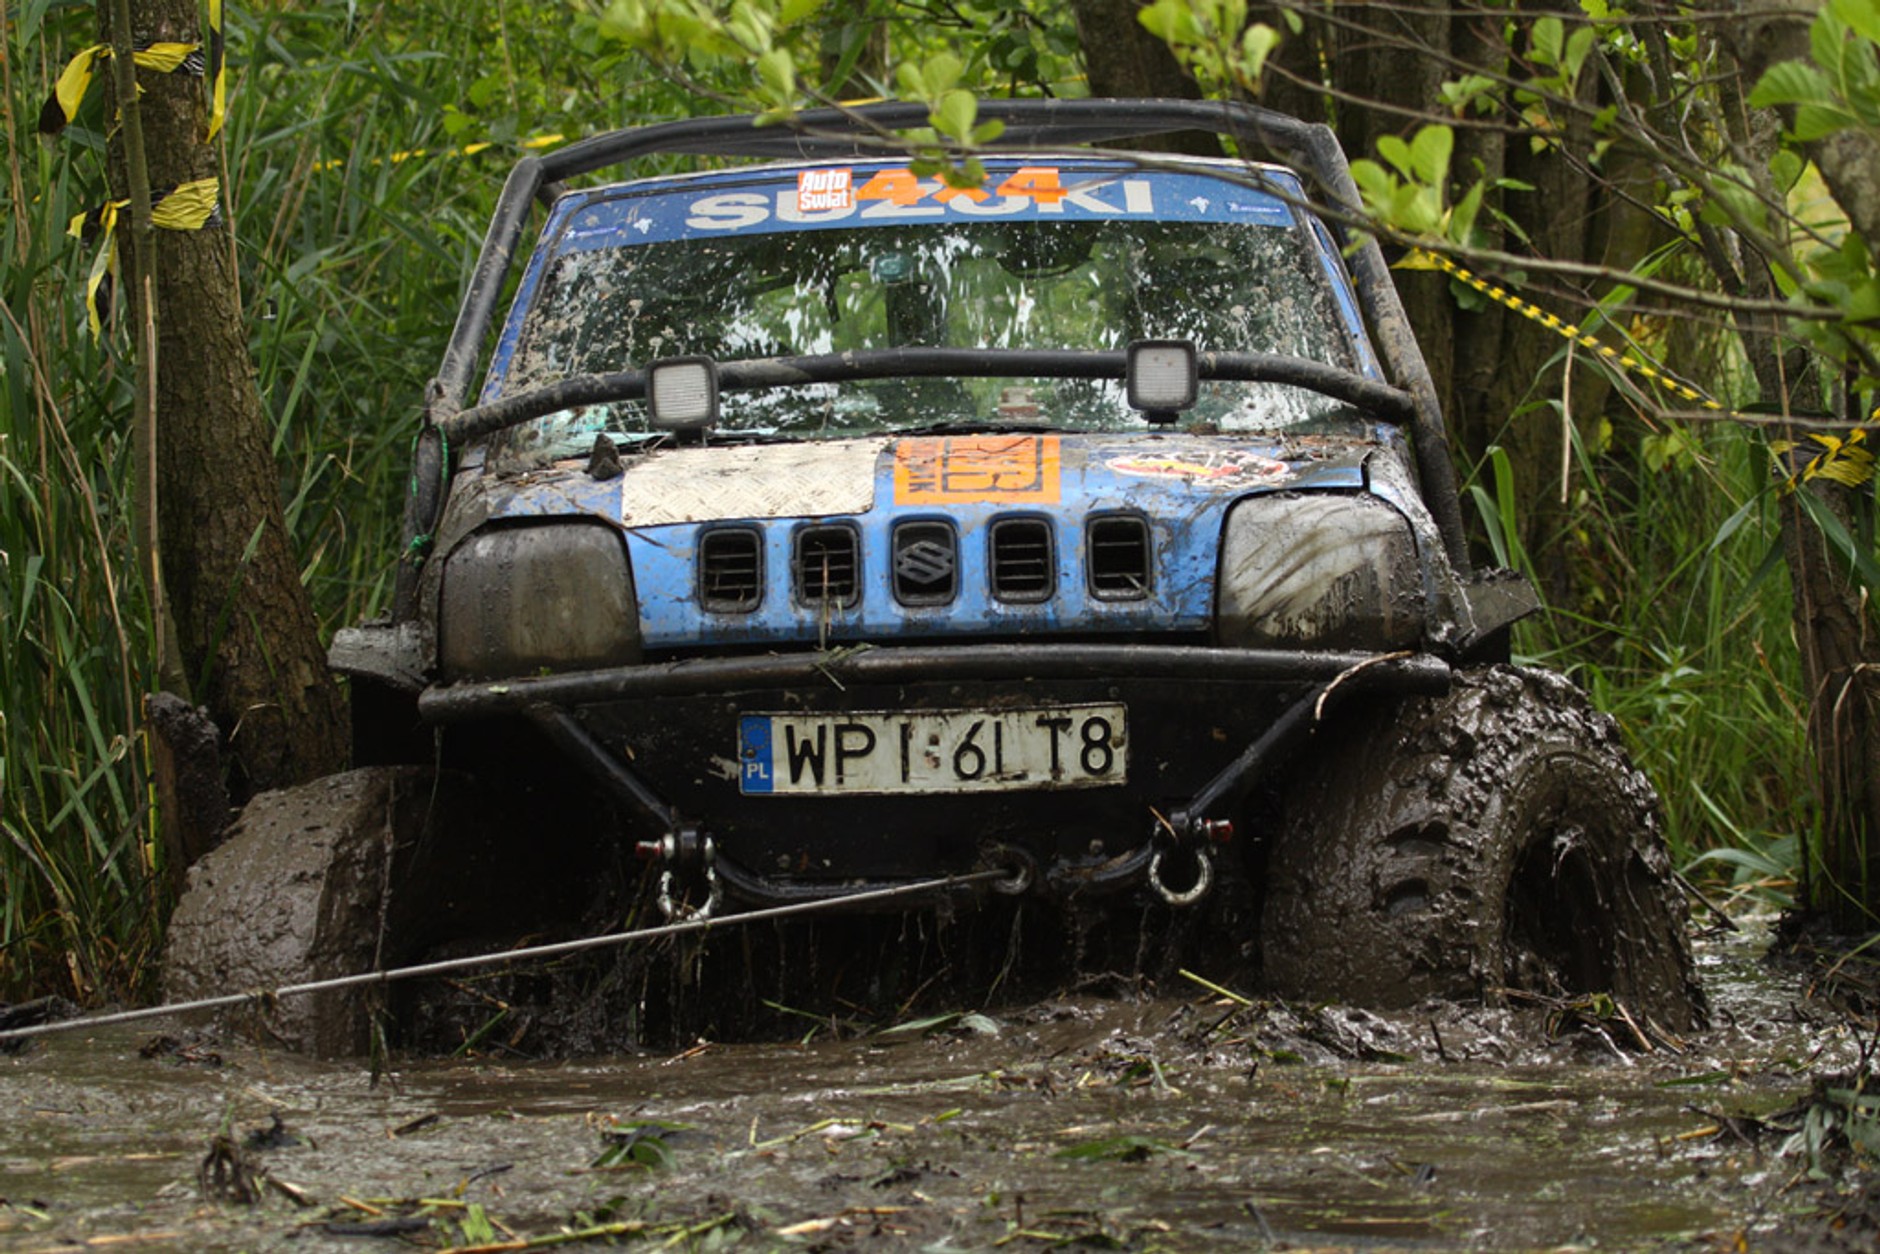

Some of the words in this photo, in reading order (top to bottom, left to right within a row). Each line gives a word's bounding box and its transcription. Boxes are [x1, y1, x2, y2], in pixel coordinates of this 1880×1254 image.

[800, 170, 848, 192] Auto
[785, 722, 911, 785] WPI
[746, 762, 769, 779] PL
